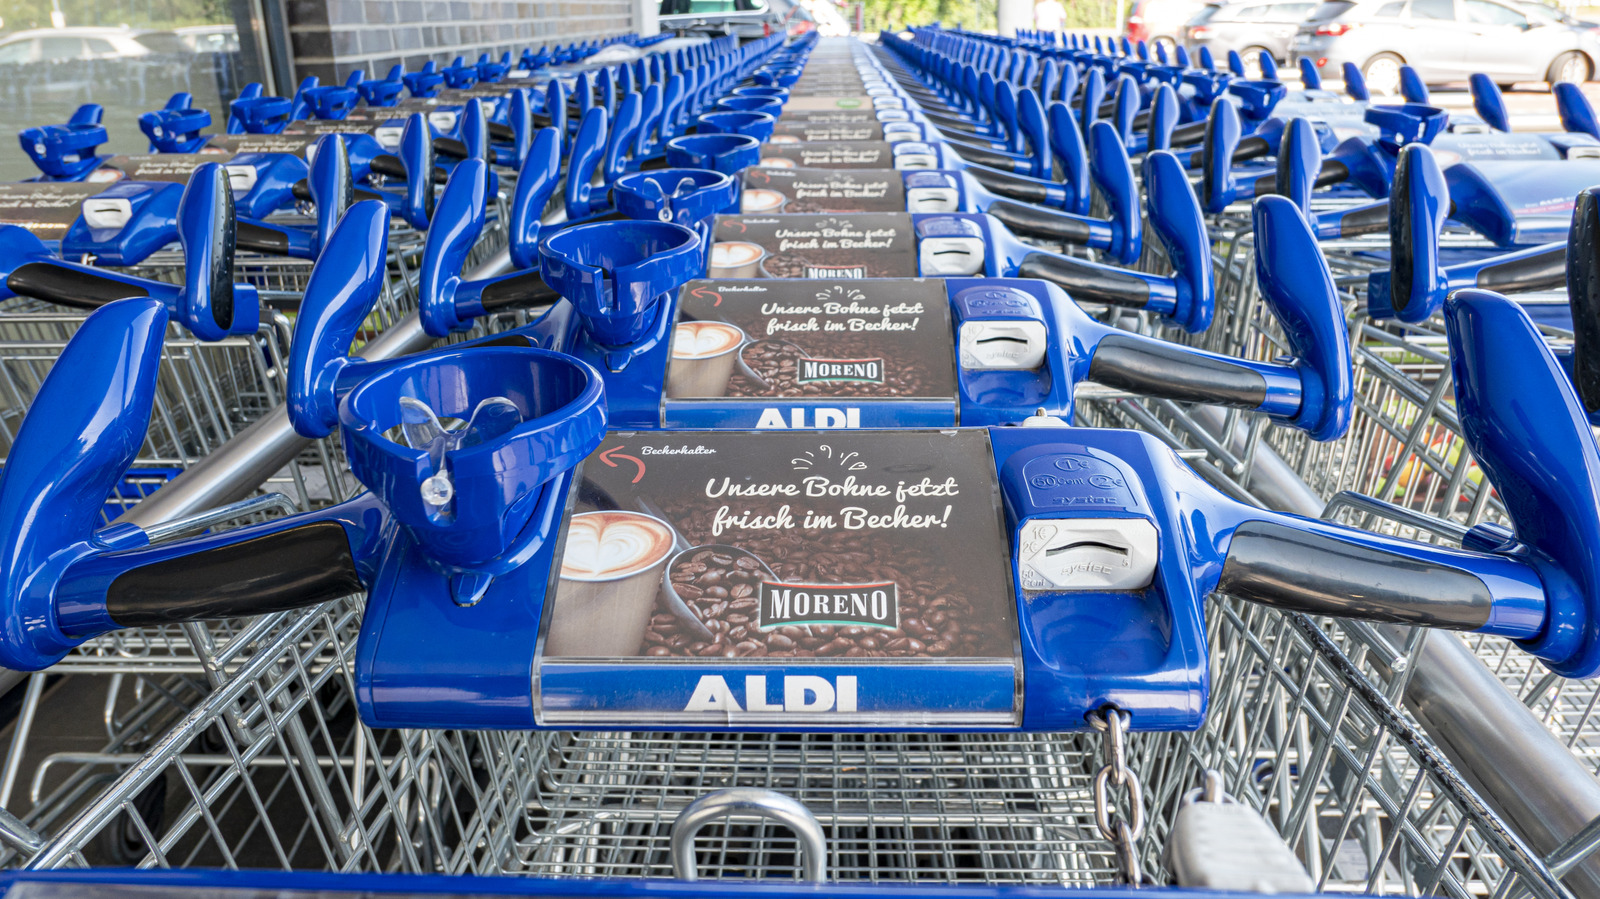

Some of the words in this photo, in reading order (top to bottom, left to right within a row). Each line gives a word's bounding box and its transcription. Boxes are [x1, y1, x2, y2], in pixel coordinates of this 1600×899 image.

[775, 229, 821, 238] Unsere
[822, 228, 864, 238] Bohne
[864, 228, 896, 240] jetzt
[780, 239, 819, 251] frisch
[822, 240, 838, 249] im
[840, 238, 893, 249] Becher!
[761, 303, 822, 315] Unsere
[823, 302, 880, 315] Bohne
[882, 302, 924, 317] jetzt
[766, 318, 820, 336] frisch
[824, 320, 846, 332] im
[848, 317, 919, 332] Becher!
[804, 361, 878, 379] MORENO
[755, 408, 860, 428] ALDI
[641, 446, 717, 455] Becherhalter
[705, 476, 800, 498] Unsere
[802, 476, 891, 497] Bohne
[894, 476, 959, 503] jetzt
[711, 504, 795, 536] frisch
[803, 510, 837, 530] im
[839, 504, 952, 530] Becher!
[1060, 562, 1113, 576] systec
[769, 589, 888, 620] MORENO
[683, 674, 858, 712] ALDI
